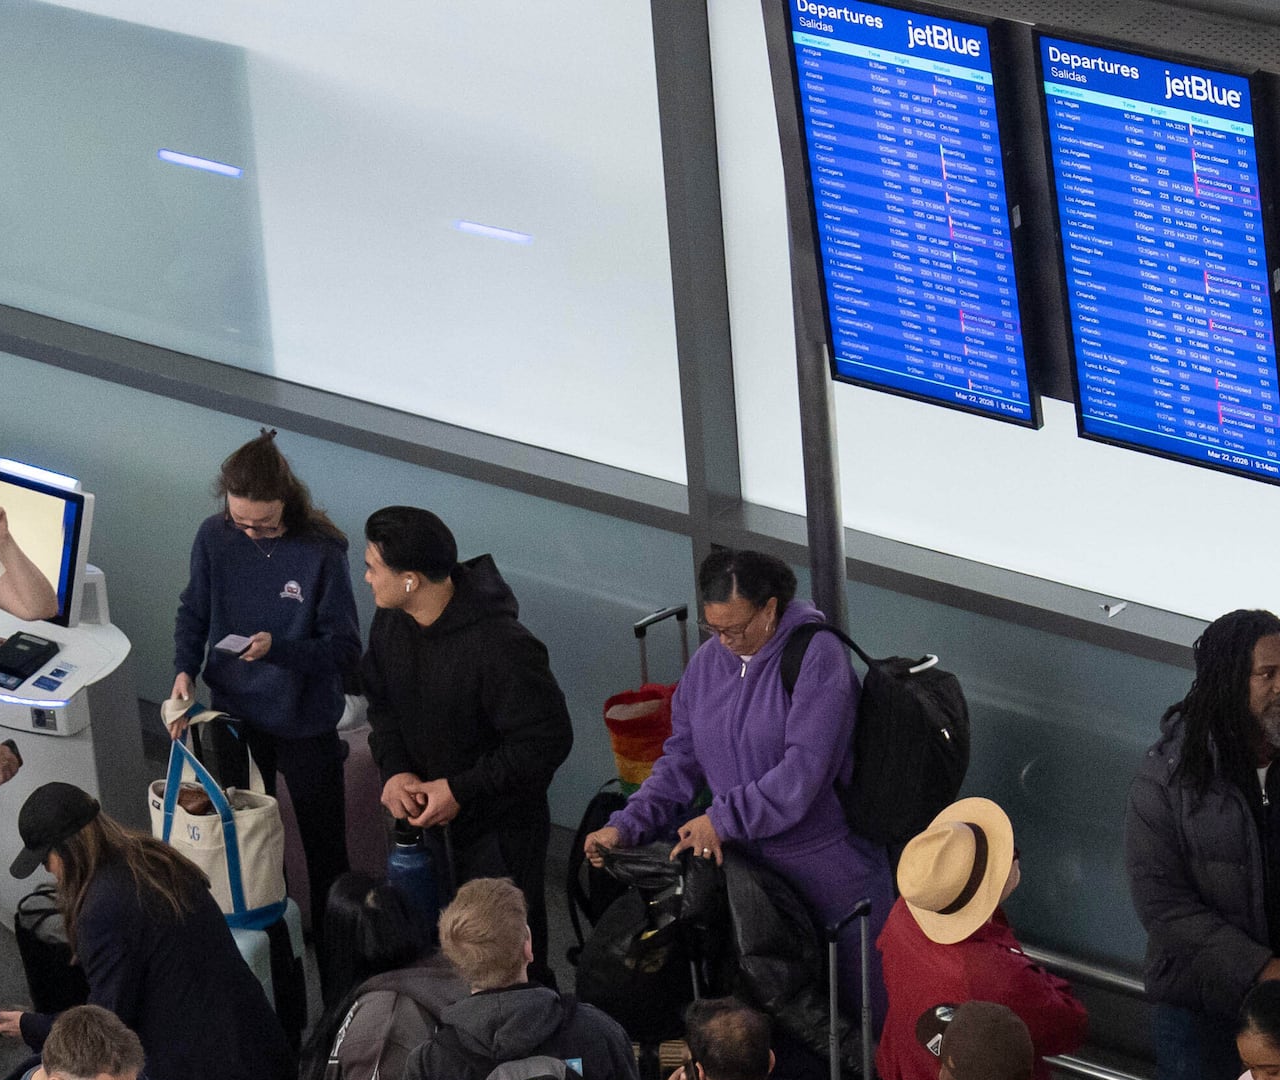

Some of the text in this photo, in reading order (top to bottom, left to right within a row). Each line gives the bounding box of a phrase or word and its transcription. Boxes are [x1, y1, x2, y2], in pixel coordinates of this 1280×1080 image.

[796, 0, 882, 28] Departures
[798, 15, 834, 33] Salidas
[908, 21, 979, 56] jetBlue
[1049, 47, 1138, 78] Departures
[1049, 65, 1087, 83] Salidas
[1166, 71, 1240, 107] jetBlue
[954, 391, 967, 401] Mar
[1206, 449, 1221, 460] Mar
